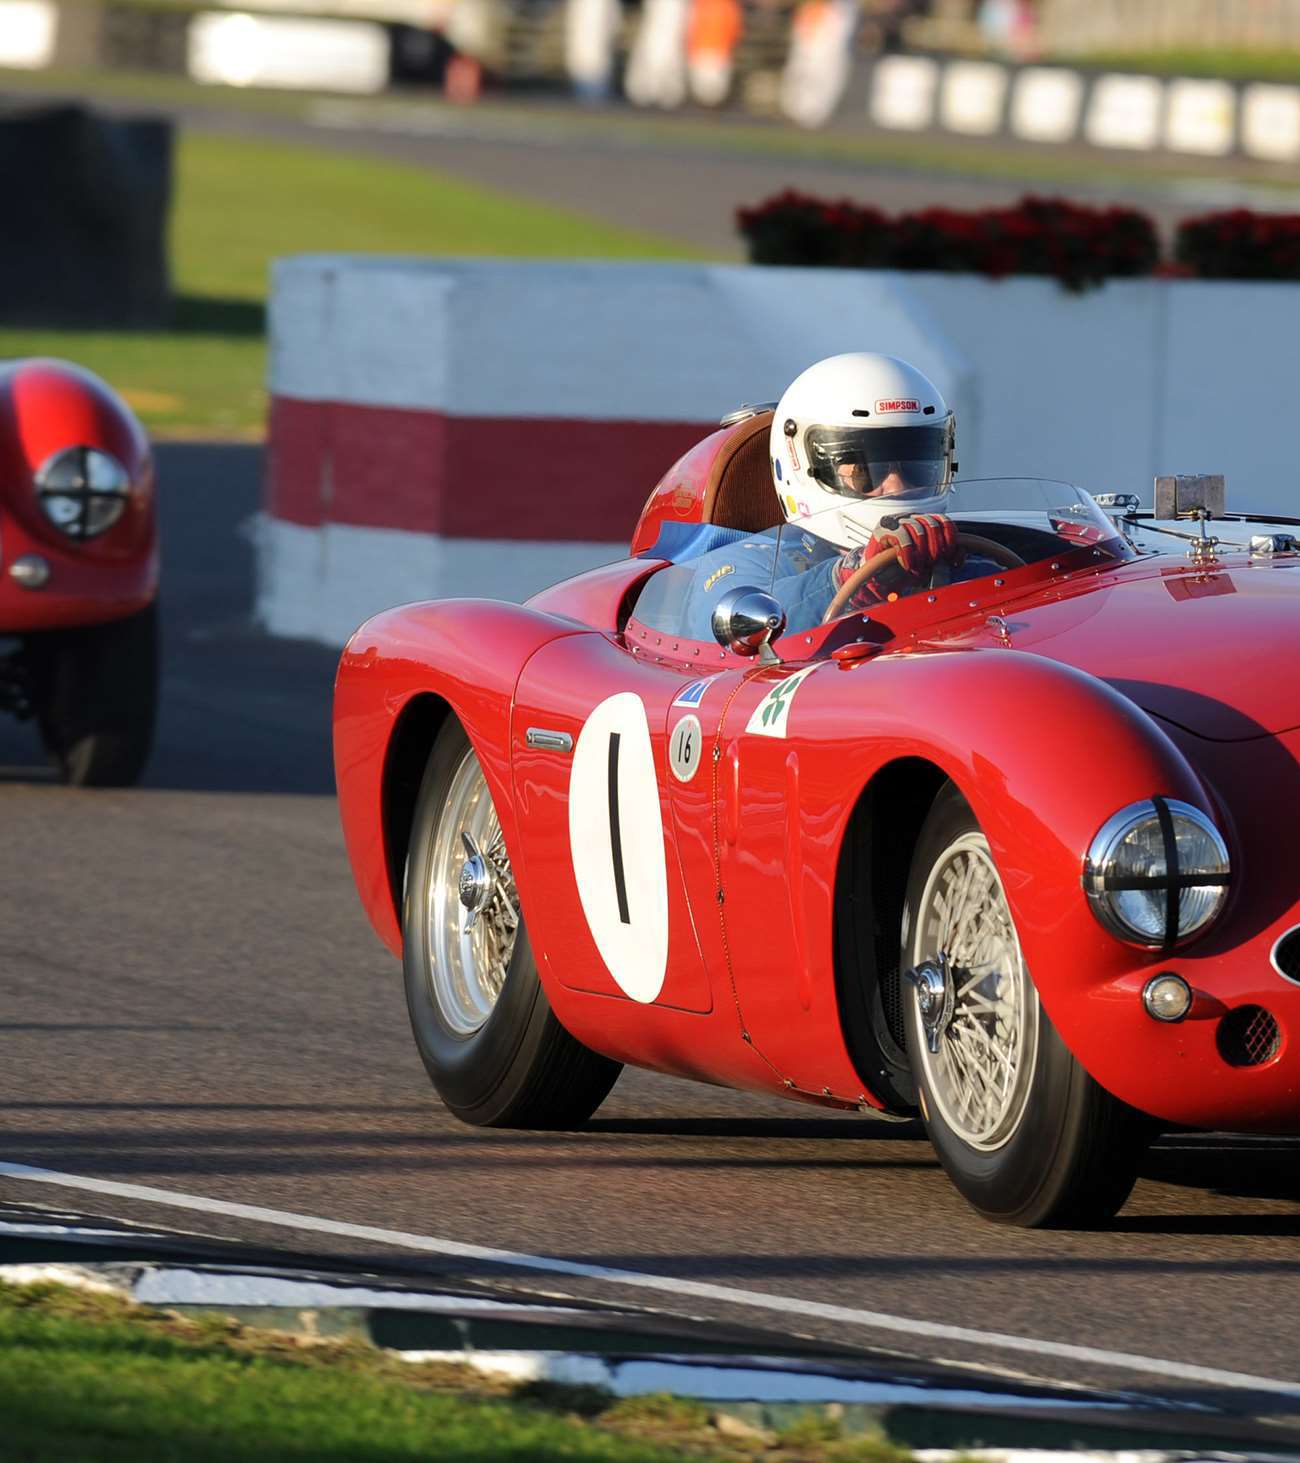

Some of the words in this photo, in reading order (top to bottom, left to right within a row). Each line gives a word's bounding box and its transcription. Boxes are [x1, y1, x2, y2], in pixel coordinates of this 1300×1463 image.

[879, 400, 918, 411] SIMPSON
[678, 731, 692, 764] 16
[607, 732, 631, 924] 1
